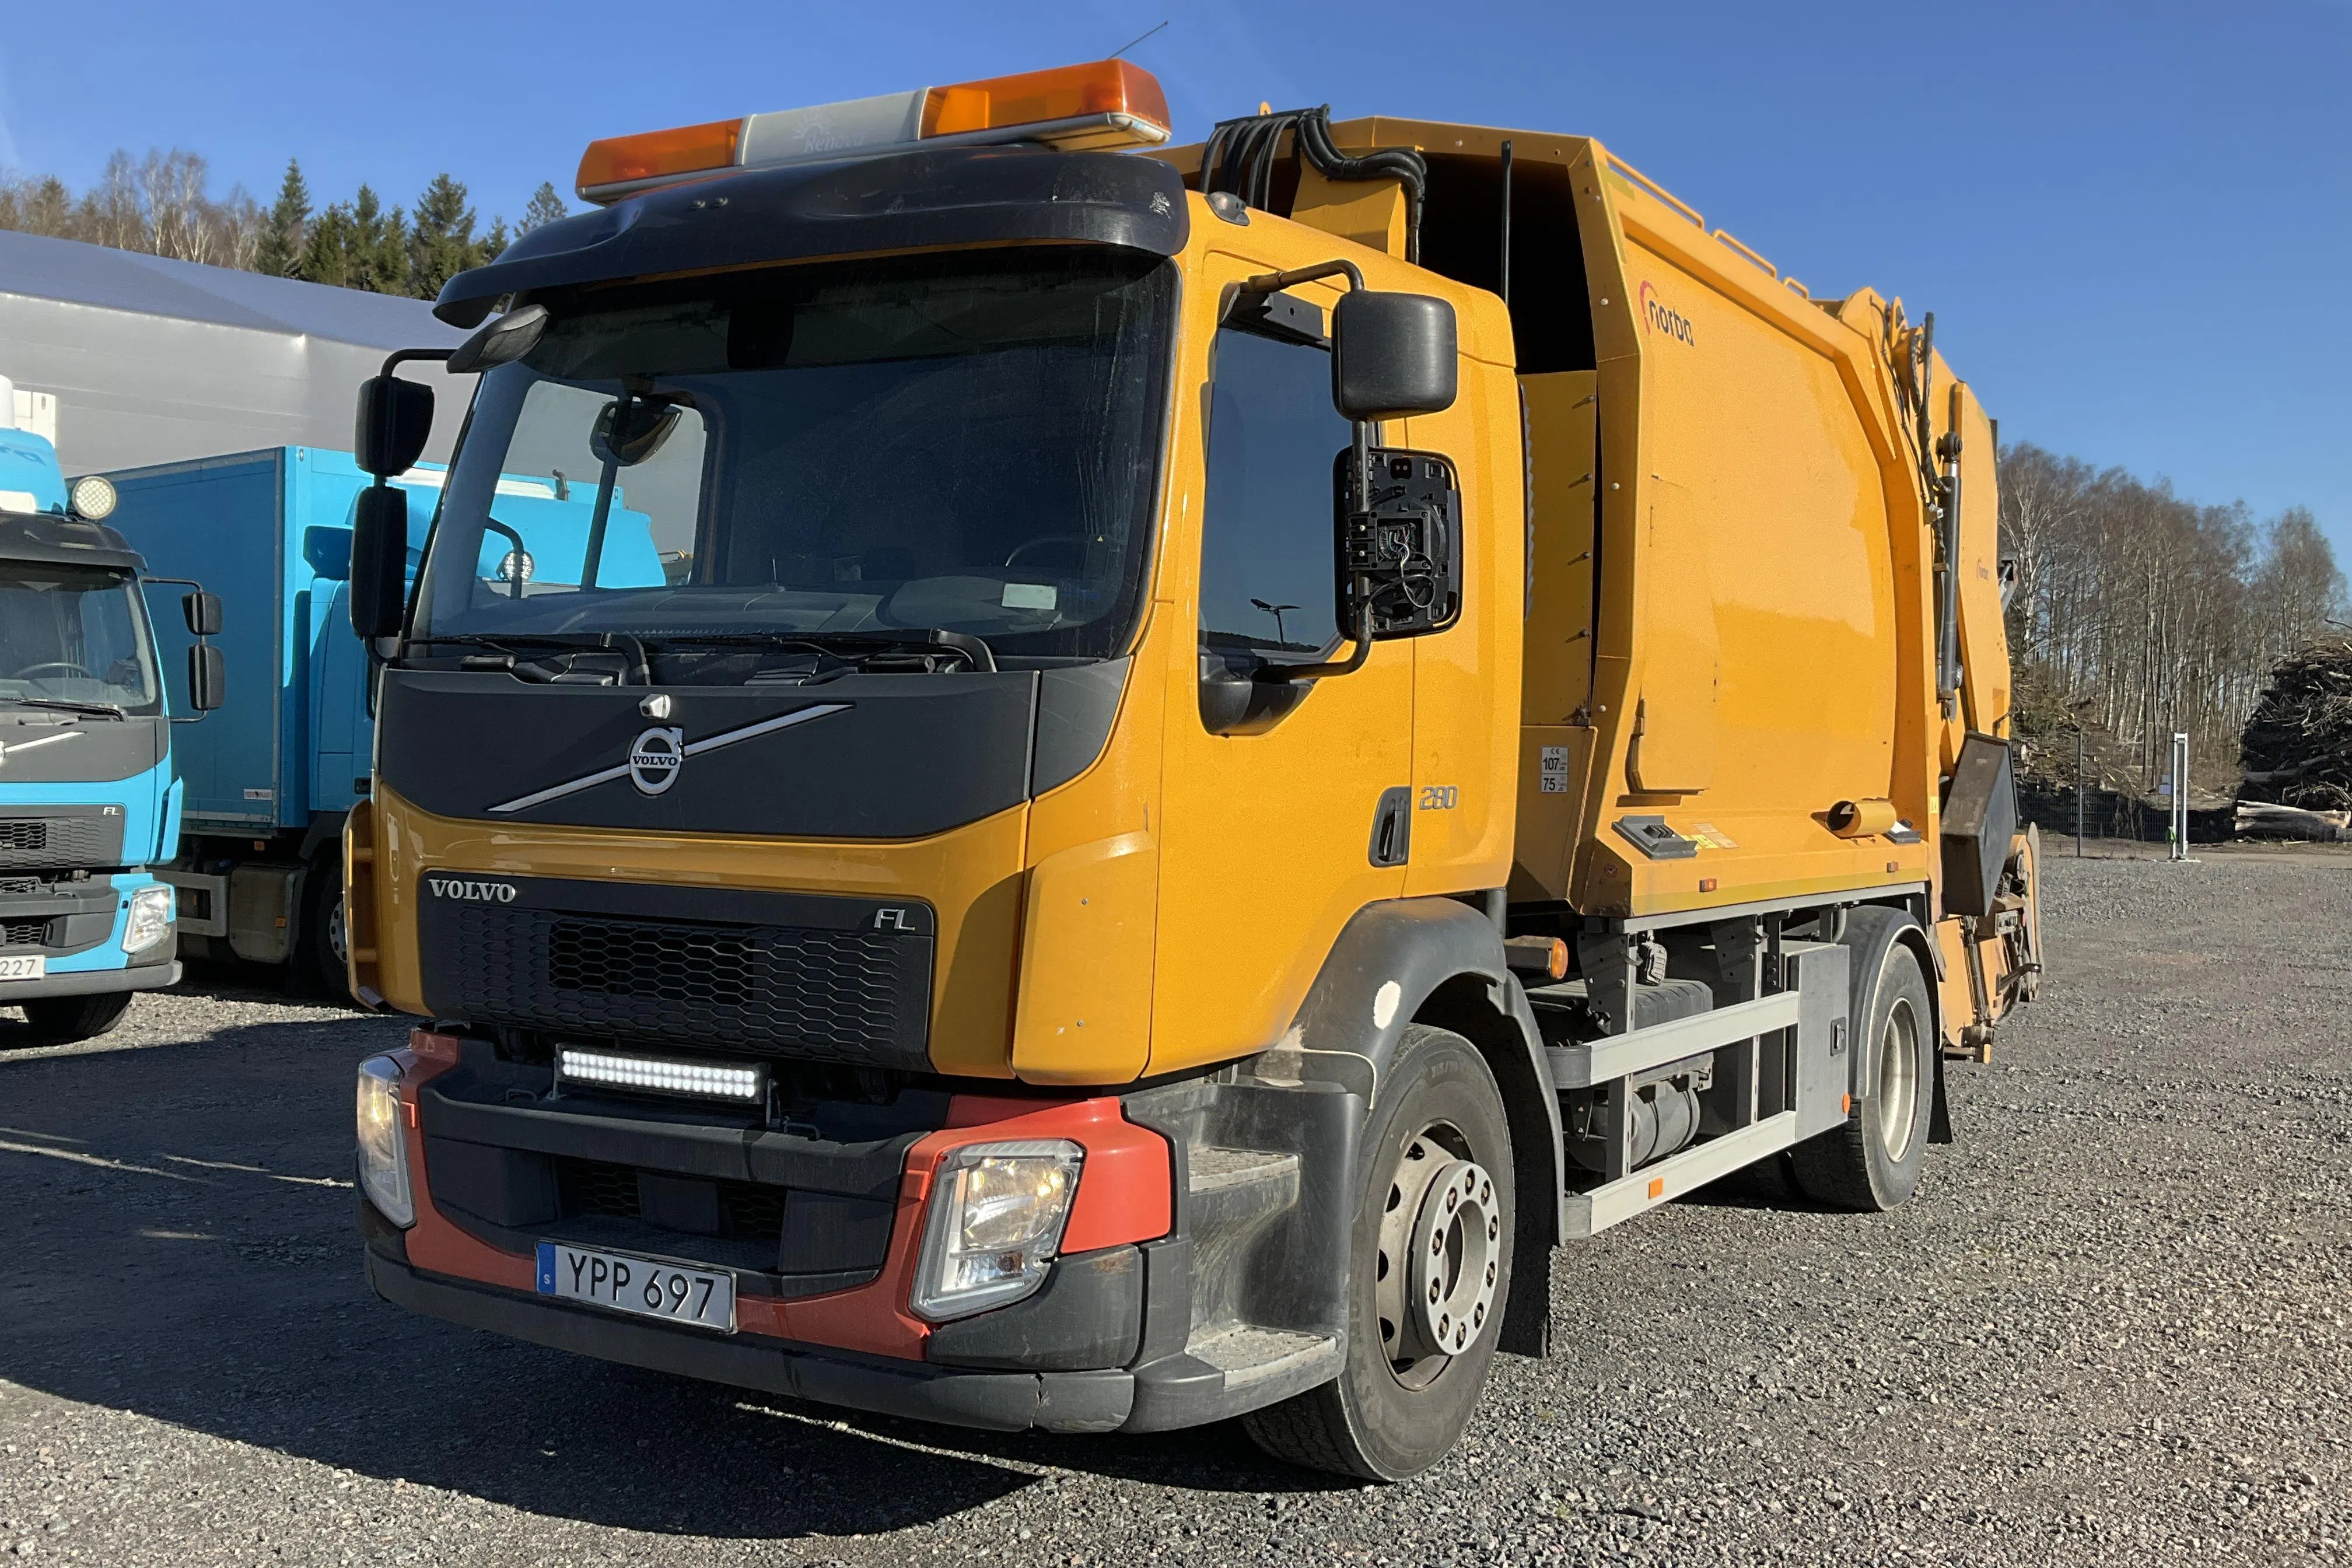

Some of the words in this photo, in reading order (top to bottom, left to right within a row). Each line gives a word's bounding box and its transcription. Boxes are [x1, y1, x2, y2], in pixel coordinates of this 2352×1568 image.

[1649, 300, 1694, 346] norba
[633, 756, 678, 766] VOLVO
[1543, 757, 1559, 770] 107
[1544, 778, 1555, 790] 75
[1419, 786, 1457, 810] 280
[103, 807, 120, 816] FL
[428, 878, 516, 902] VOLVO
[874, 908, 915, 930] FL
[0, 959, 36, 976] 227
[543, 1273, 551, 1284] S
[568, 1253, 631, 1301] YPP
[643, 1269, 715, 1319] 697
